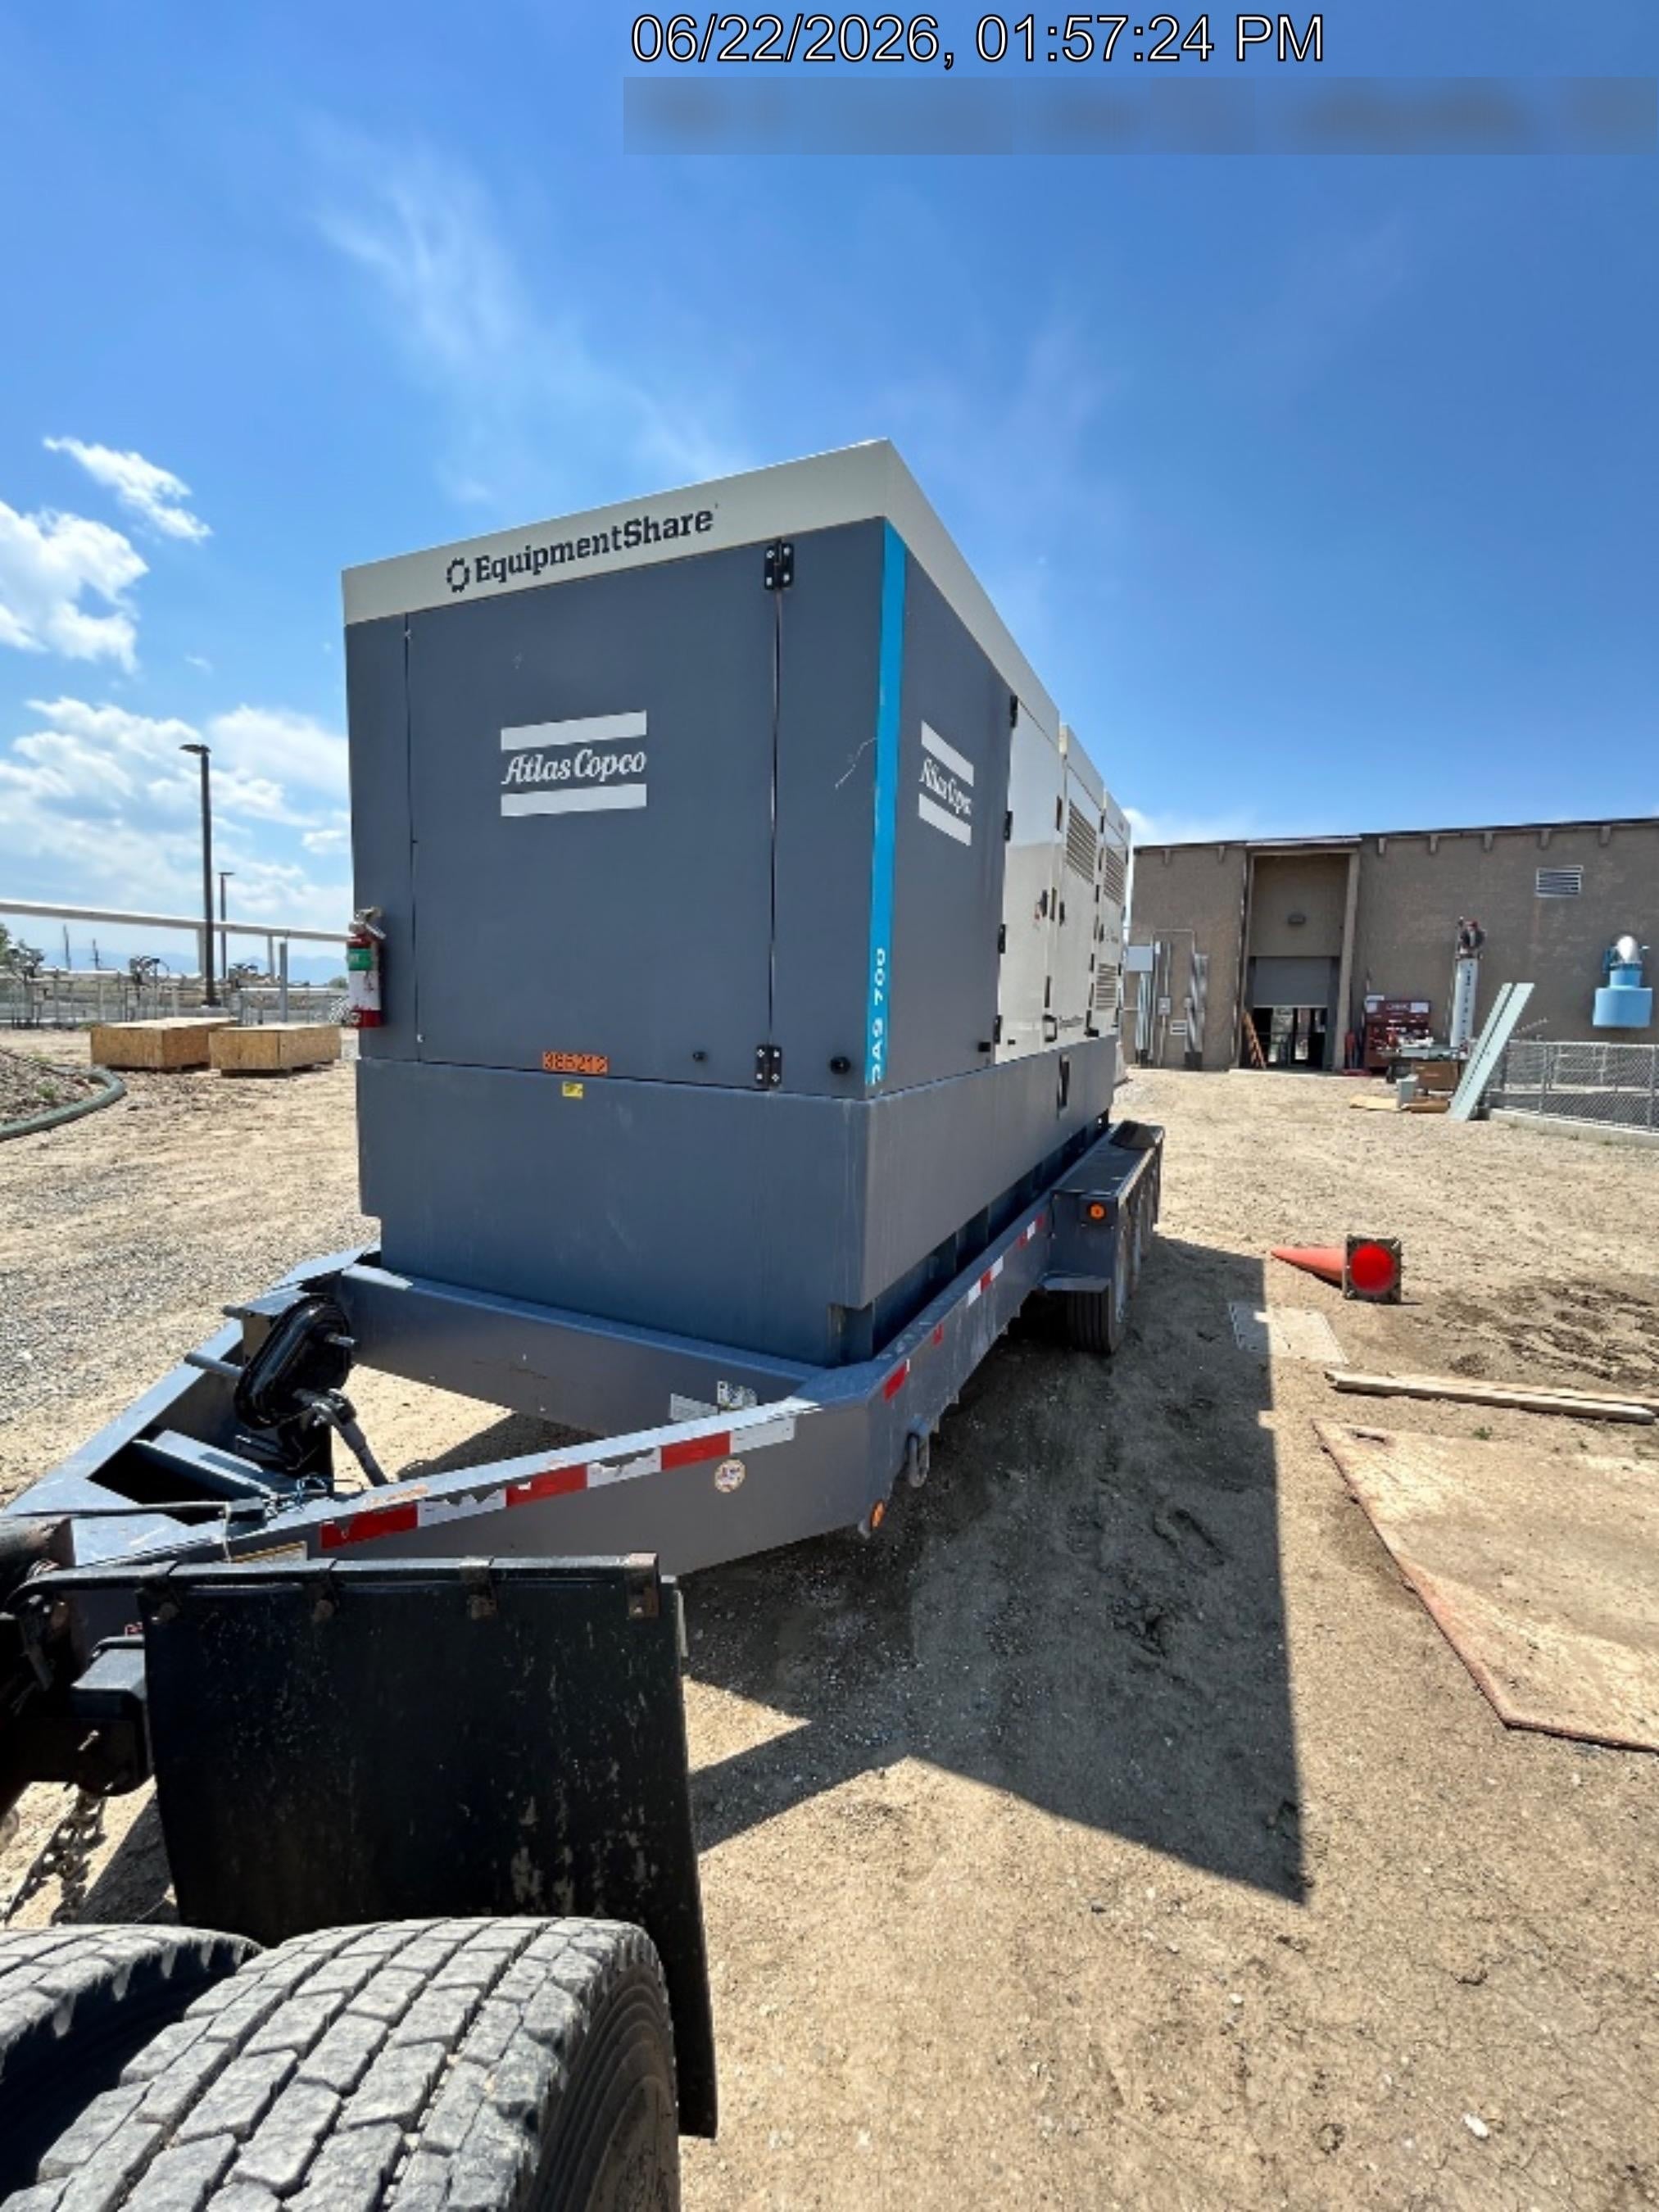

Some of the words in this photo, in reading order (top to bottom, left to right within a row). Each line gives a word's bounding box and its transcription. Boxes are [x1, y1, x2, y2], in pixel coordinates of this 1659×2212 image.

[475, 510, 714, 582] EquipmentShare
[501, 754, 571, 785] Atlas
[574, 748, 646, 782] Copco
[873, 947, 886, 1007] 700
